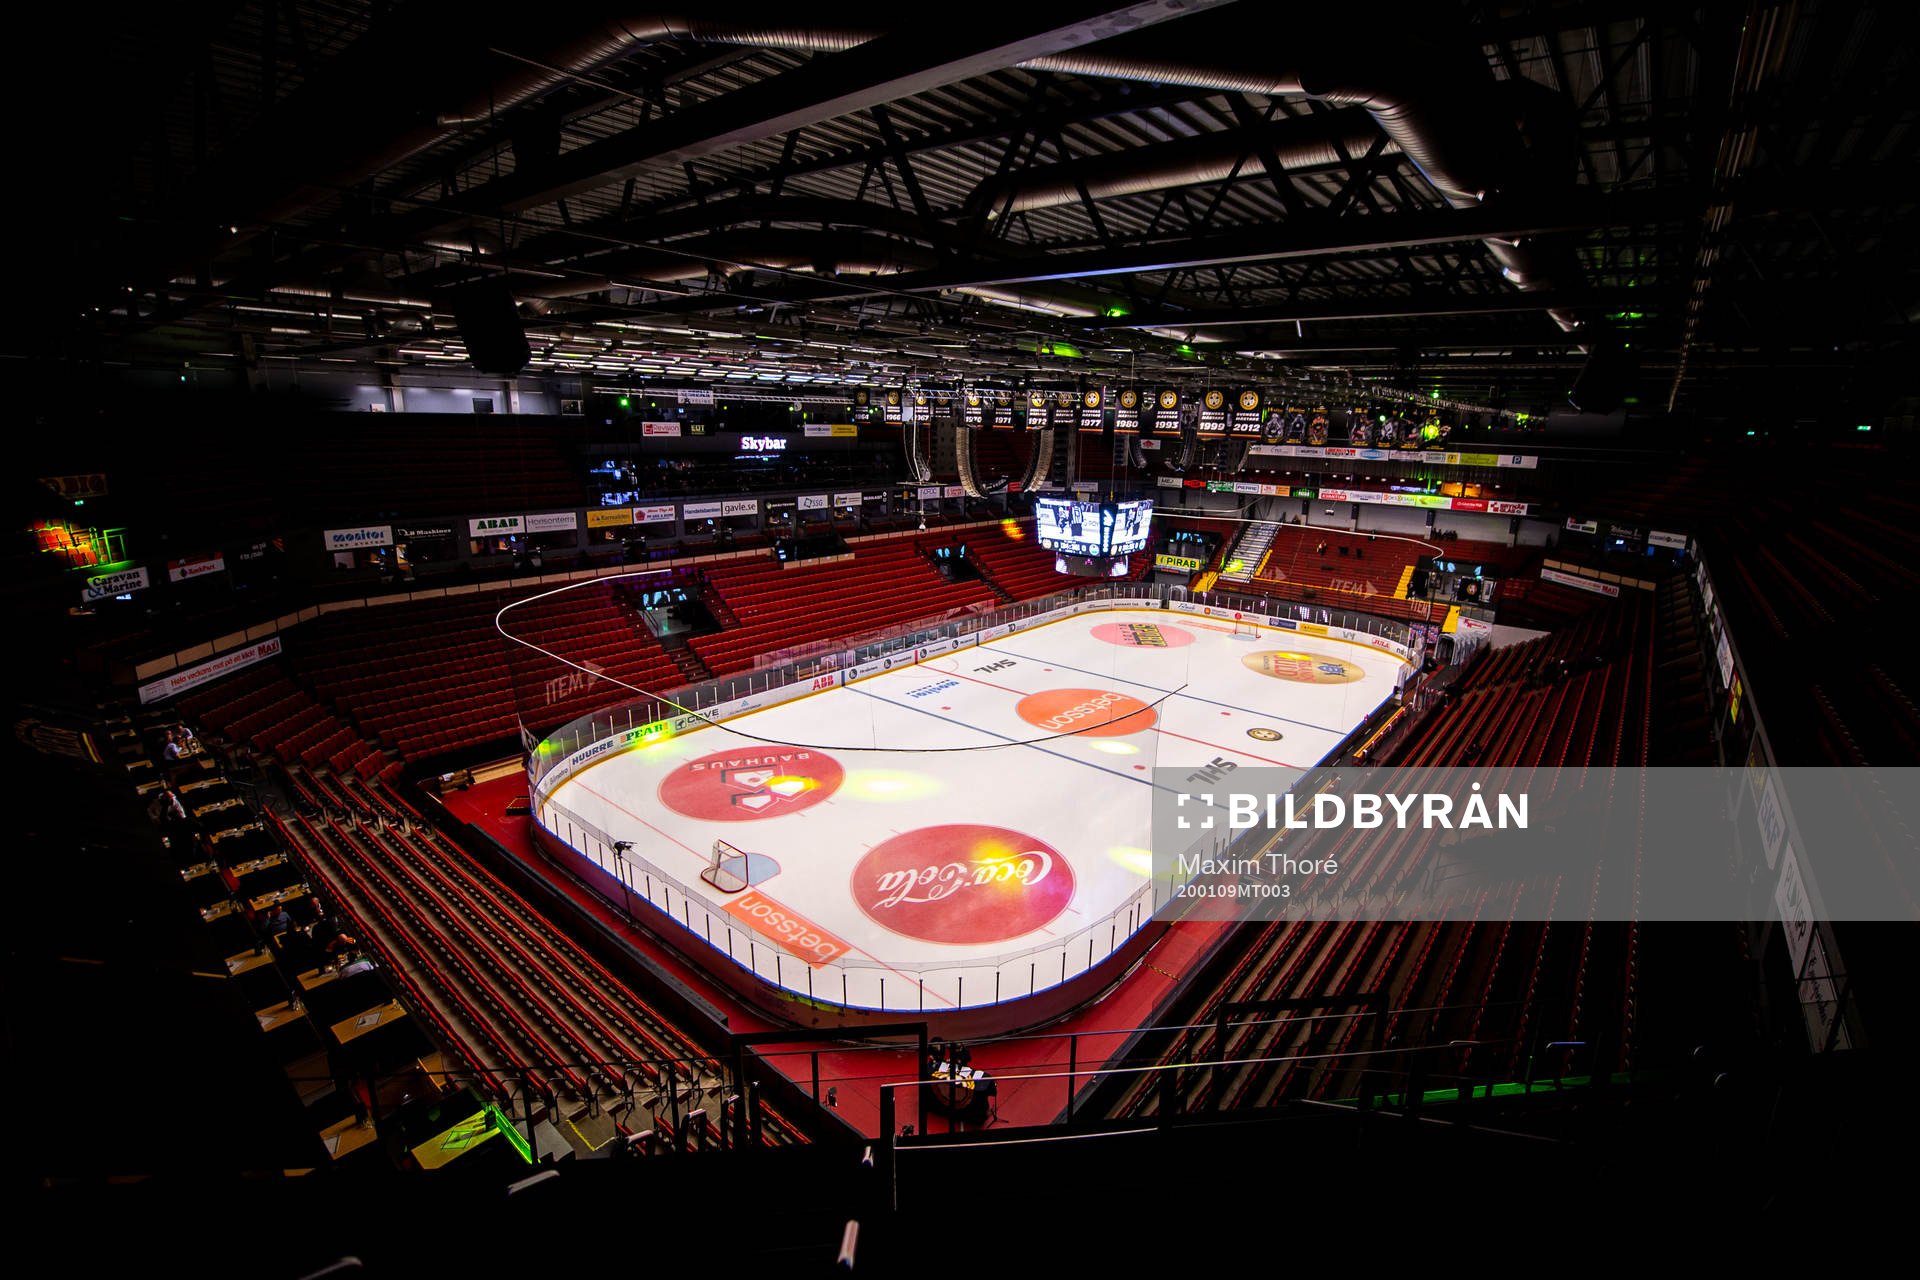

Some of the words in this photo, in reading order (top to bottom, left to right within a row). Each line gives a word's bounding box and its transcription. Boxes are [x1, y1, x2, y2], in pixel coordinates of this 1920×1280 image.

[1080, 419, 1102, 427] 1977
[1115, 420, 1139, 428] 1980
[1155, 420, 1179, 429] 1993
[1199, 422, 1226, 431] 1999
[1232, 423, 1261, 432] 2012
[741, 436, 787, 453] Skybar
[476, 518, 519, 530] ABAB
[333, 530, 384, 543] monitor
[1166, 557, 1197, 569] PIRAB
[93, 570, 141, 587] Caravan
[87, 585, 104, 599] &
[104, 579, 143, 595] Marine
[972, 659, 1017, 674] SHL
[170, 676, 187, 688] Hela
[188, 667, 212, 682] veckans
[213, 664, 224, 675] mat
[813, 675, 834, 691] ABB
[1039, 692, 1129, 730] betsson
[572, 740, 614, 765] HUURRE
[690, 752, 810, 772] BAUHAUS
[1186, 756, 1239, 786] SHL
[739, 894, 842, 963] betsson
